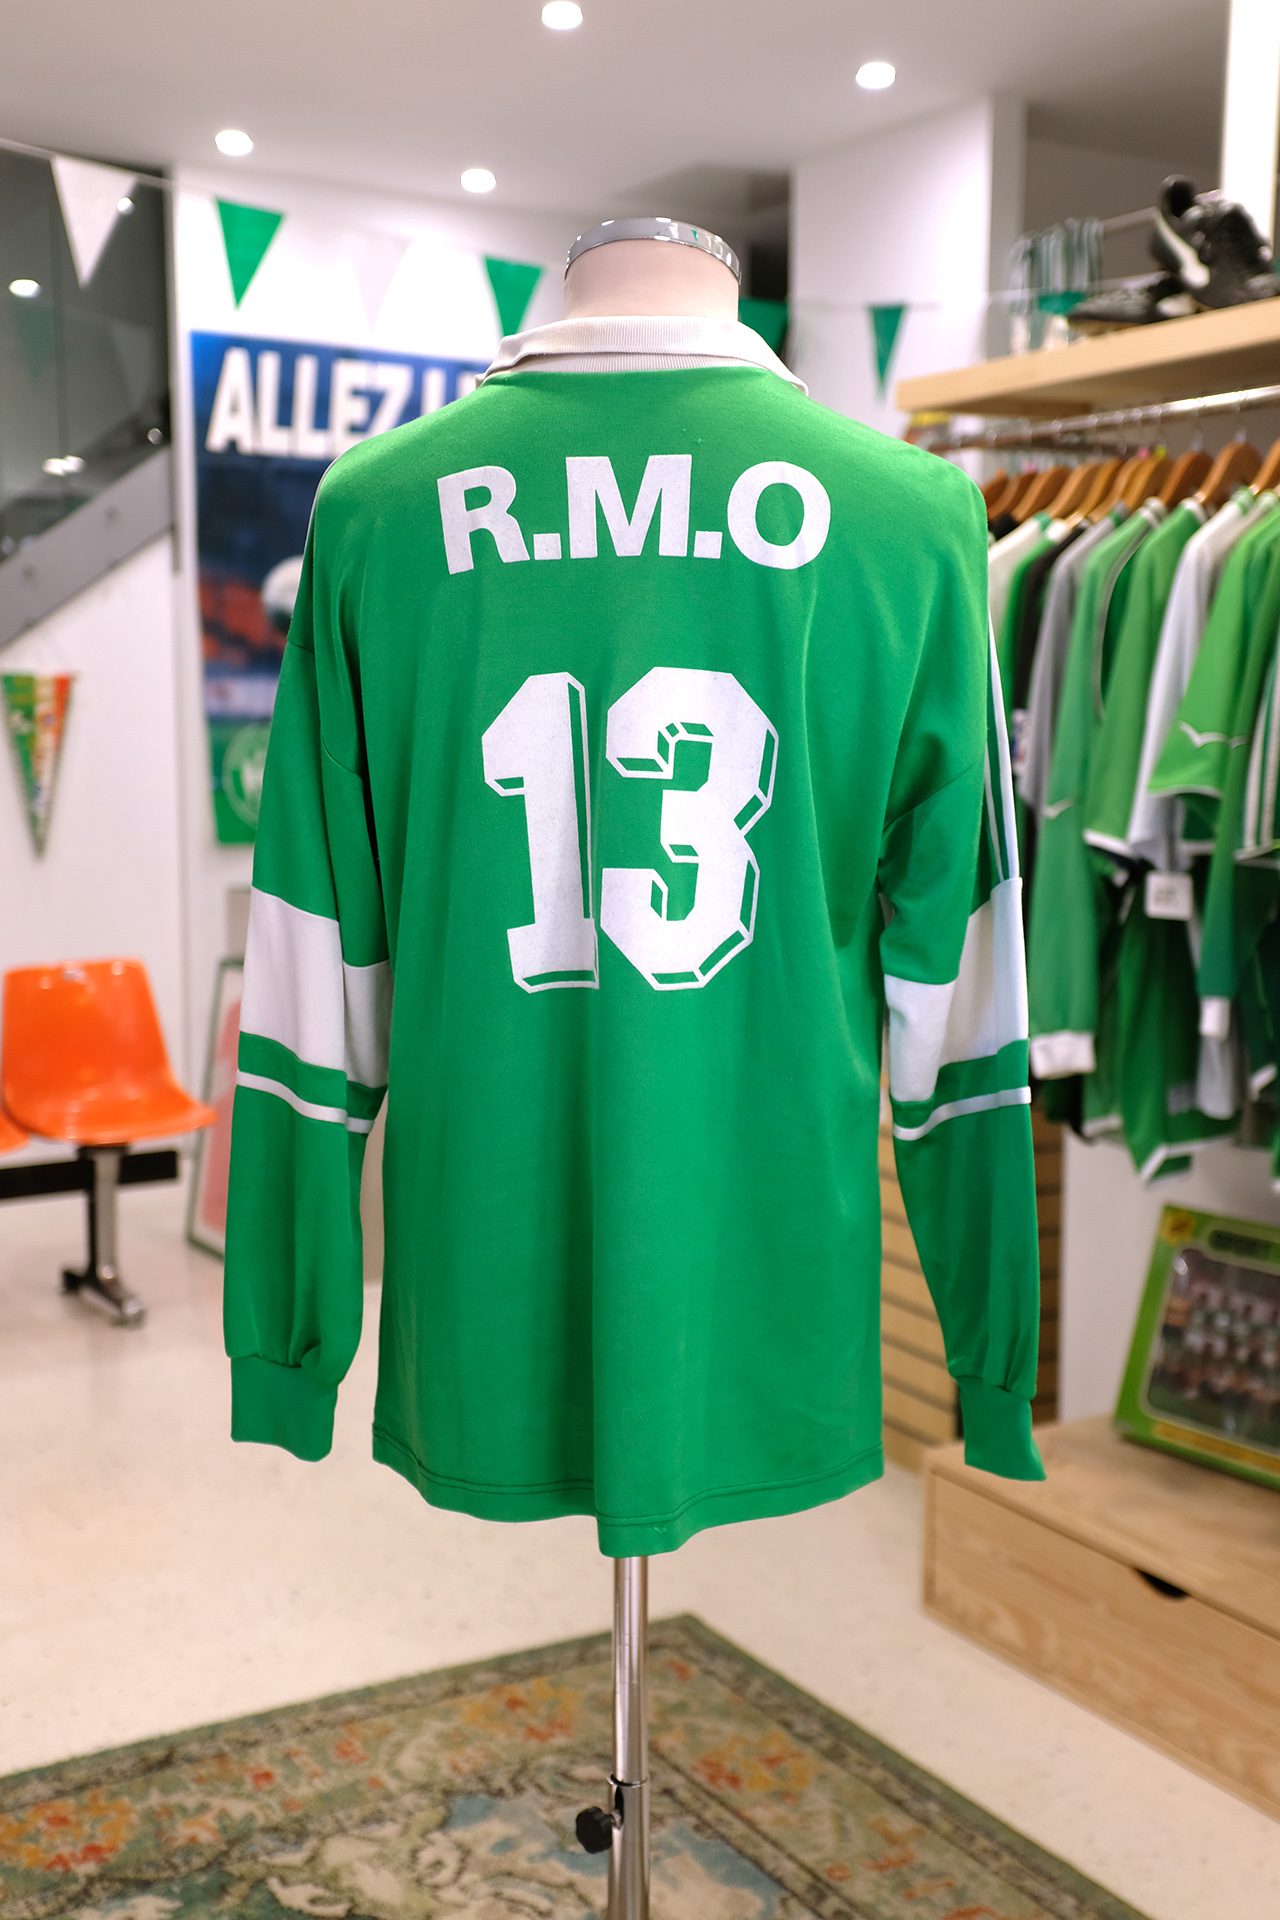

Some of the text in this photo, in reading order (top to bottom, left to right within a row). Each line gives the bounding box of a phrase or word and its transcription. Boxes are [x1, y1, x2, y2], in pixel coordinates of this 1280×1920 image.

[205, 346, 413, 459] ALLEZ
[437, 454, 832, 574] R.M.O
[482, 667, 778, 993] 13
